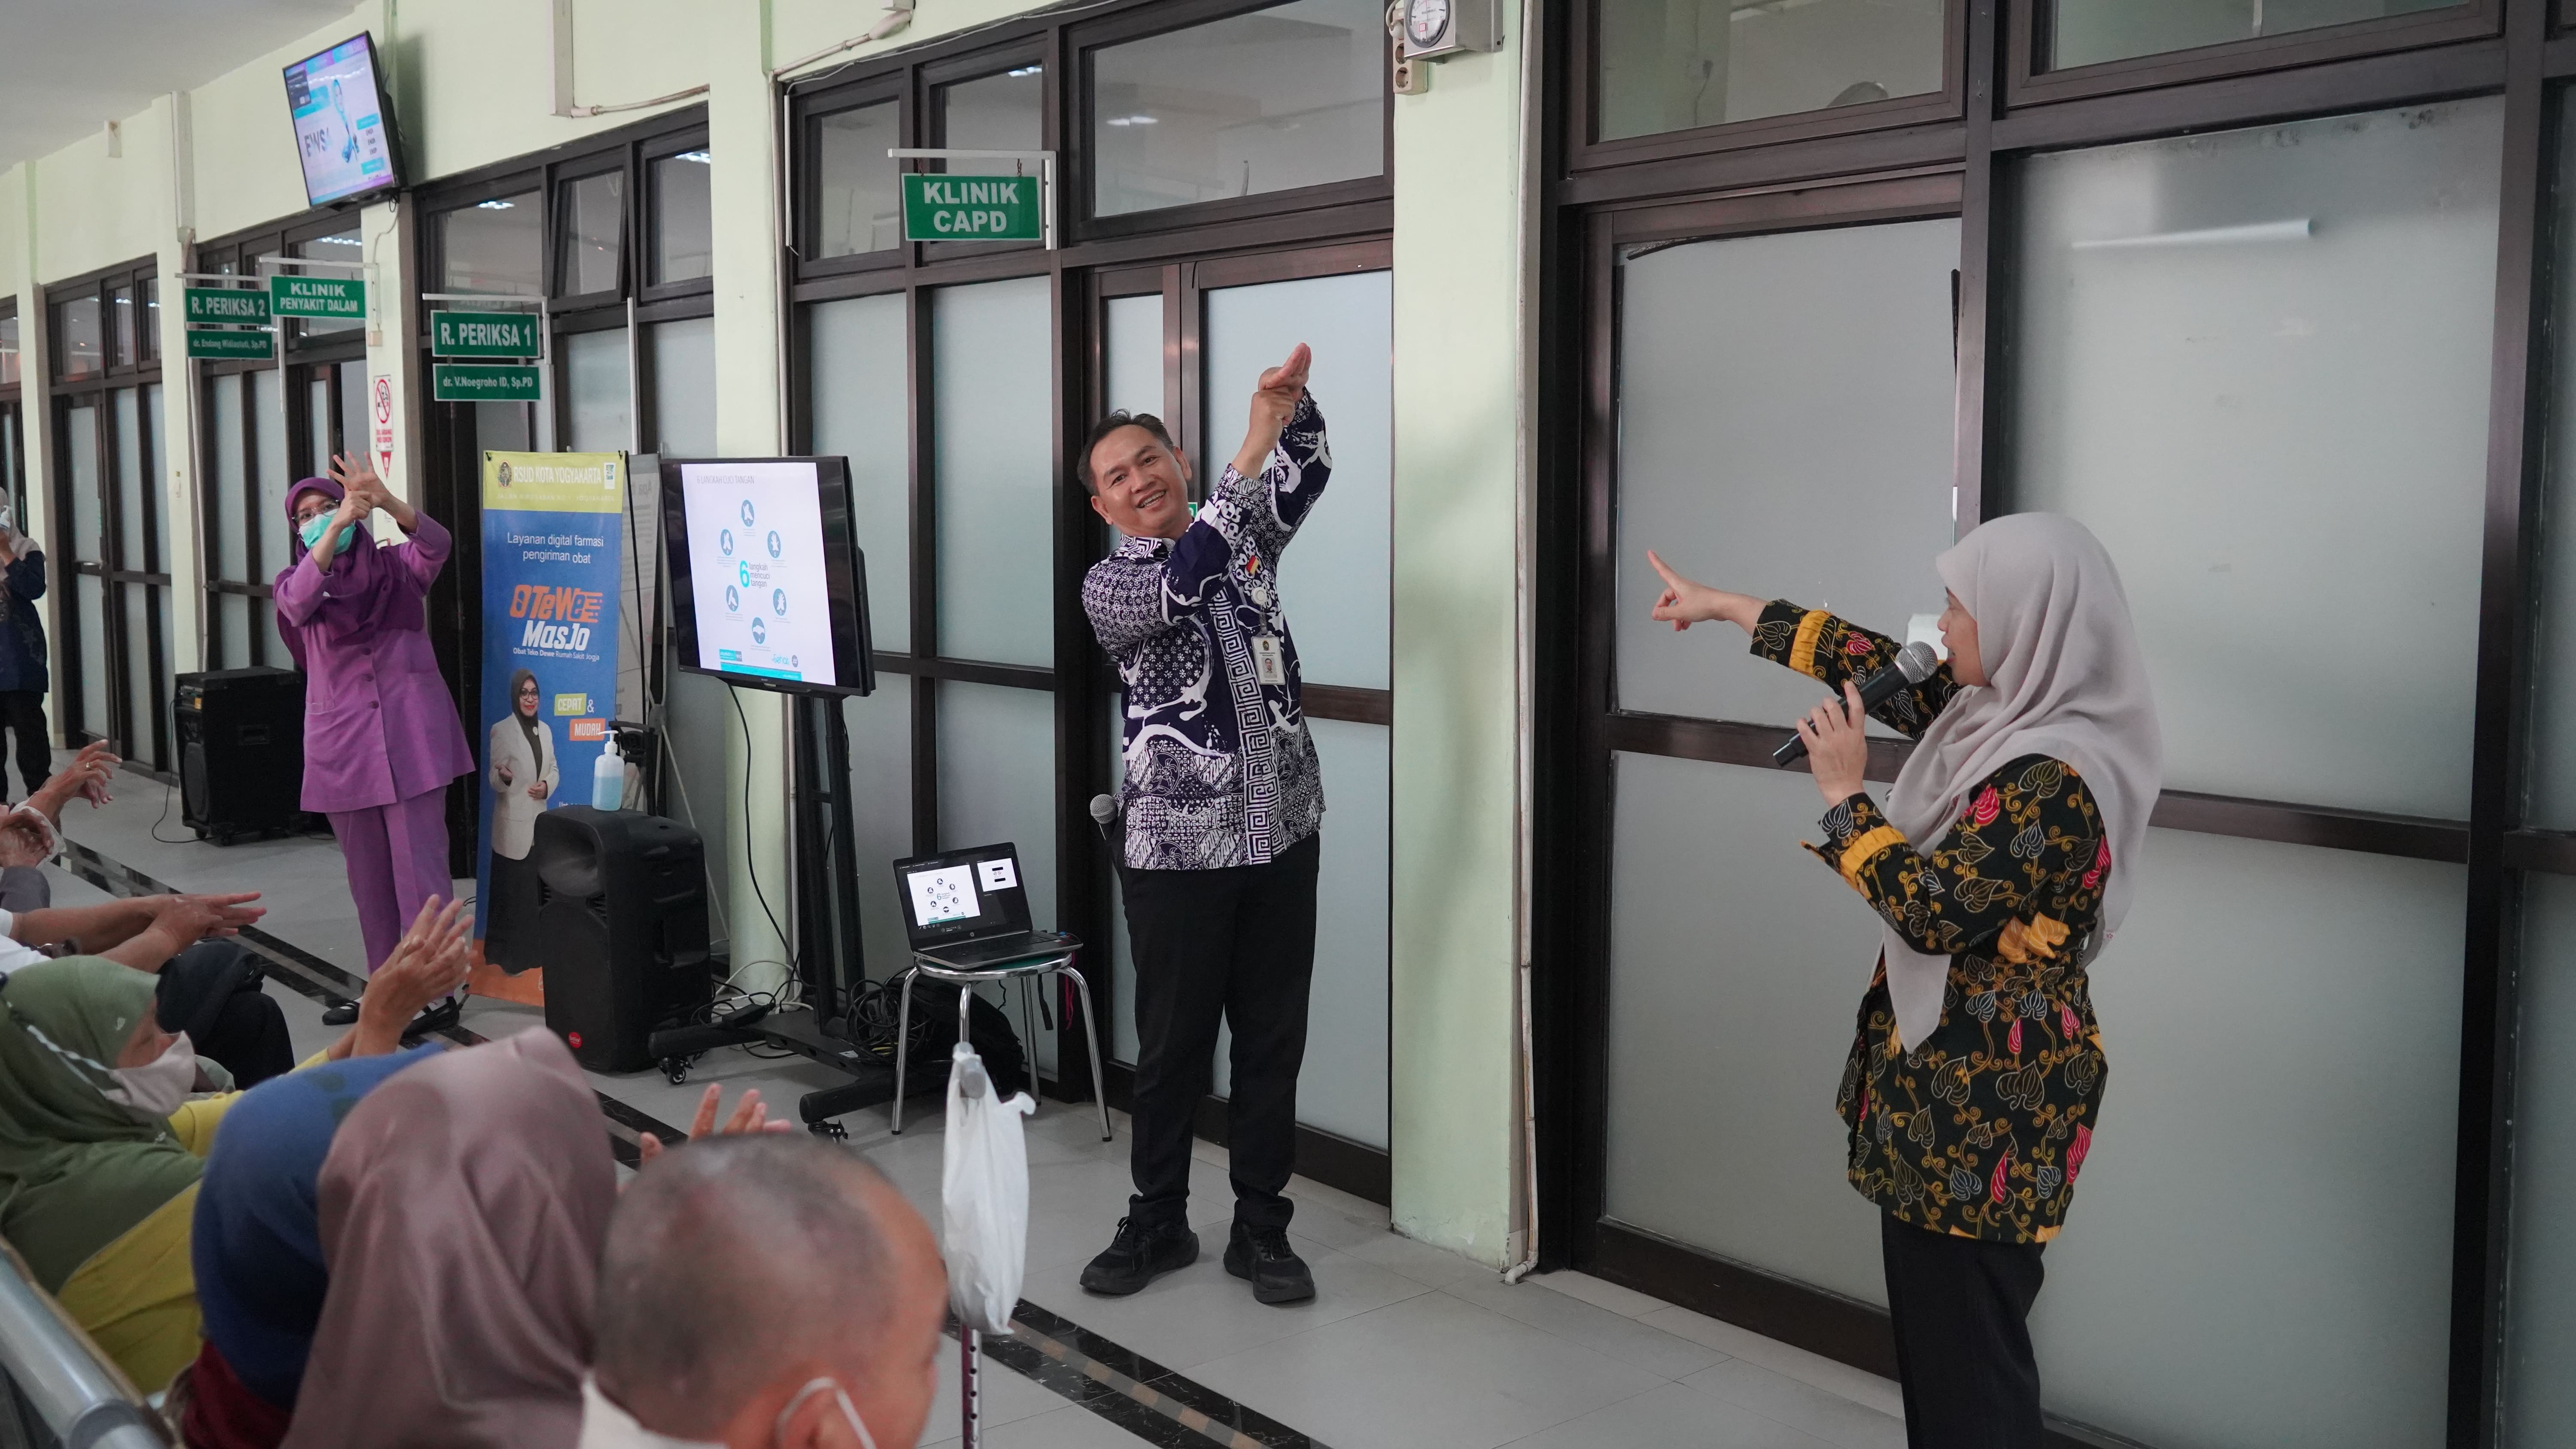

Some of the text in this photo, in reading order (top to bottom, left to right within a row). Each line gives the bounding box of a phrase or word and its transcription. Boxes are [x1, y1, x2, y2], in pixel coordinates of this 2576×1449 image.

[923, 182, 1020, 204] KLINIK
[934, 210, 1007, 232] CAPD
[291, 282, 345, 297] KLINIK
[191, 296, 265, 316] R. PERIKSA 2
[280, 297, 357, 312] PENYAKIT DALAM
[440, 322, 531, 346] R. PERIKSA 1
[443, 376, 453, 387] dr.
[499, 377, 510, 389] ID,
[511, 377, 533, 389] Sp.PD
[513, 467, 601, 484] RSUD KOTA YOGYAKARTA
[701, 476, 722, 484] LANGKAH
[735, 476, 754, 484] TANGAN
[507, 532, 604, 548] Layanan digital farmasi
[523, 549, 591, 564] pengiriman obat
[740, 560, 750, 588] 6
[749, 562, 768, 572] langkah
[751, 579, 767, 588] tangan
[558, 698, 594, 713] CEPAT &
[574, 723, 601, 736] MUDAH
